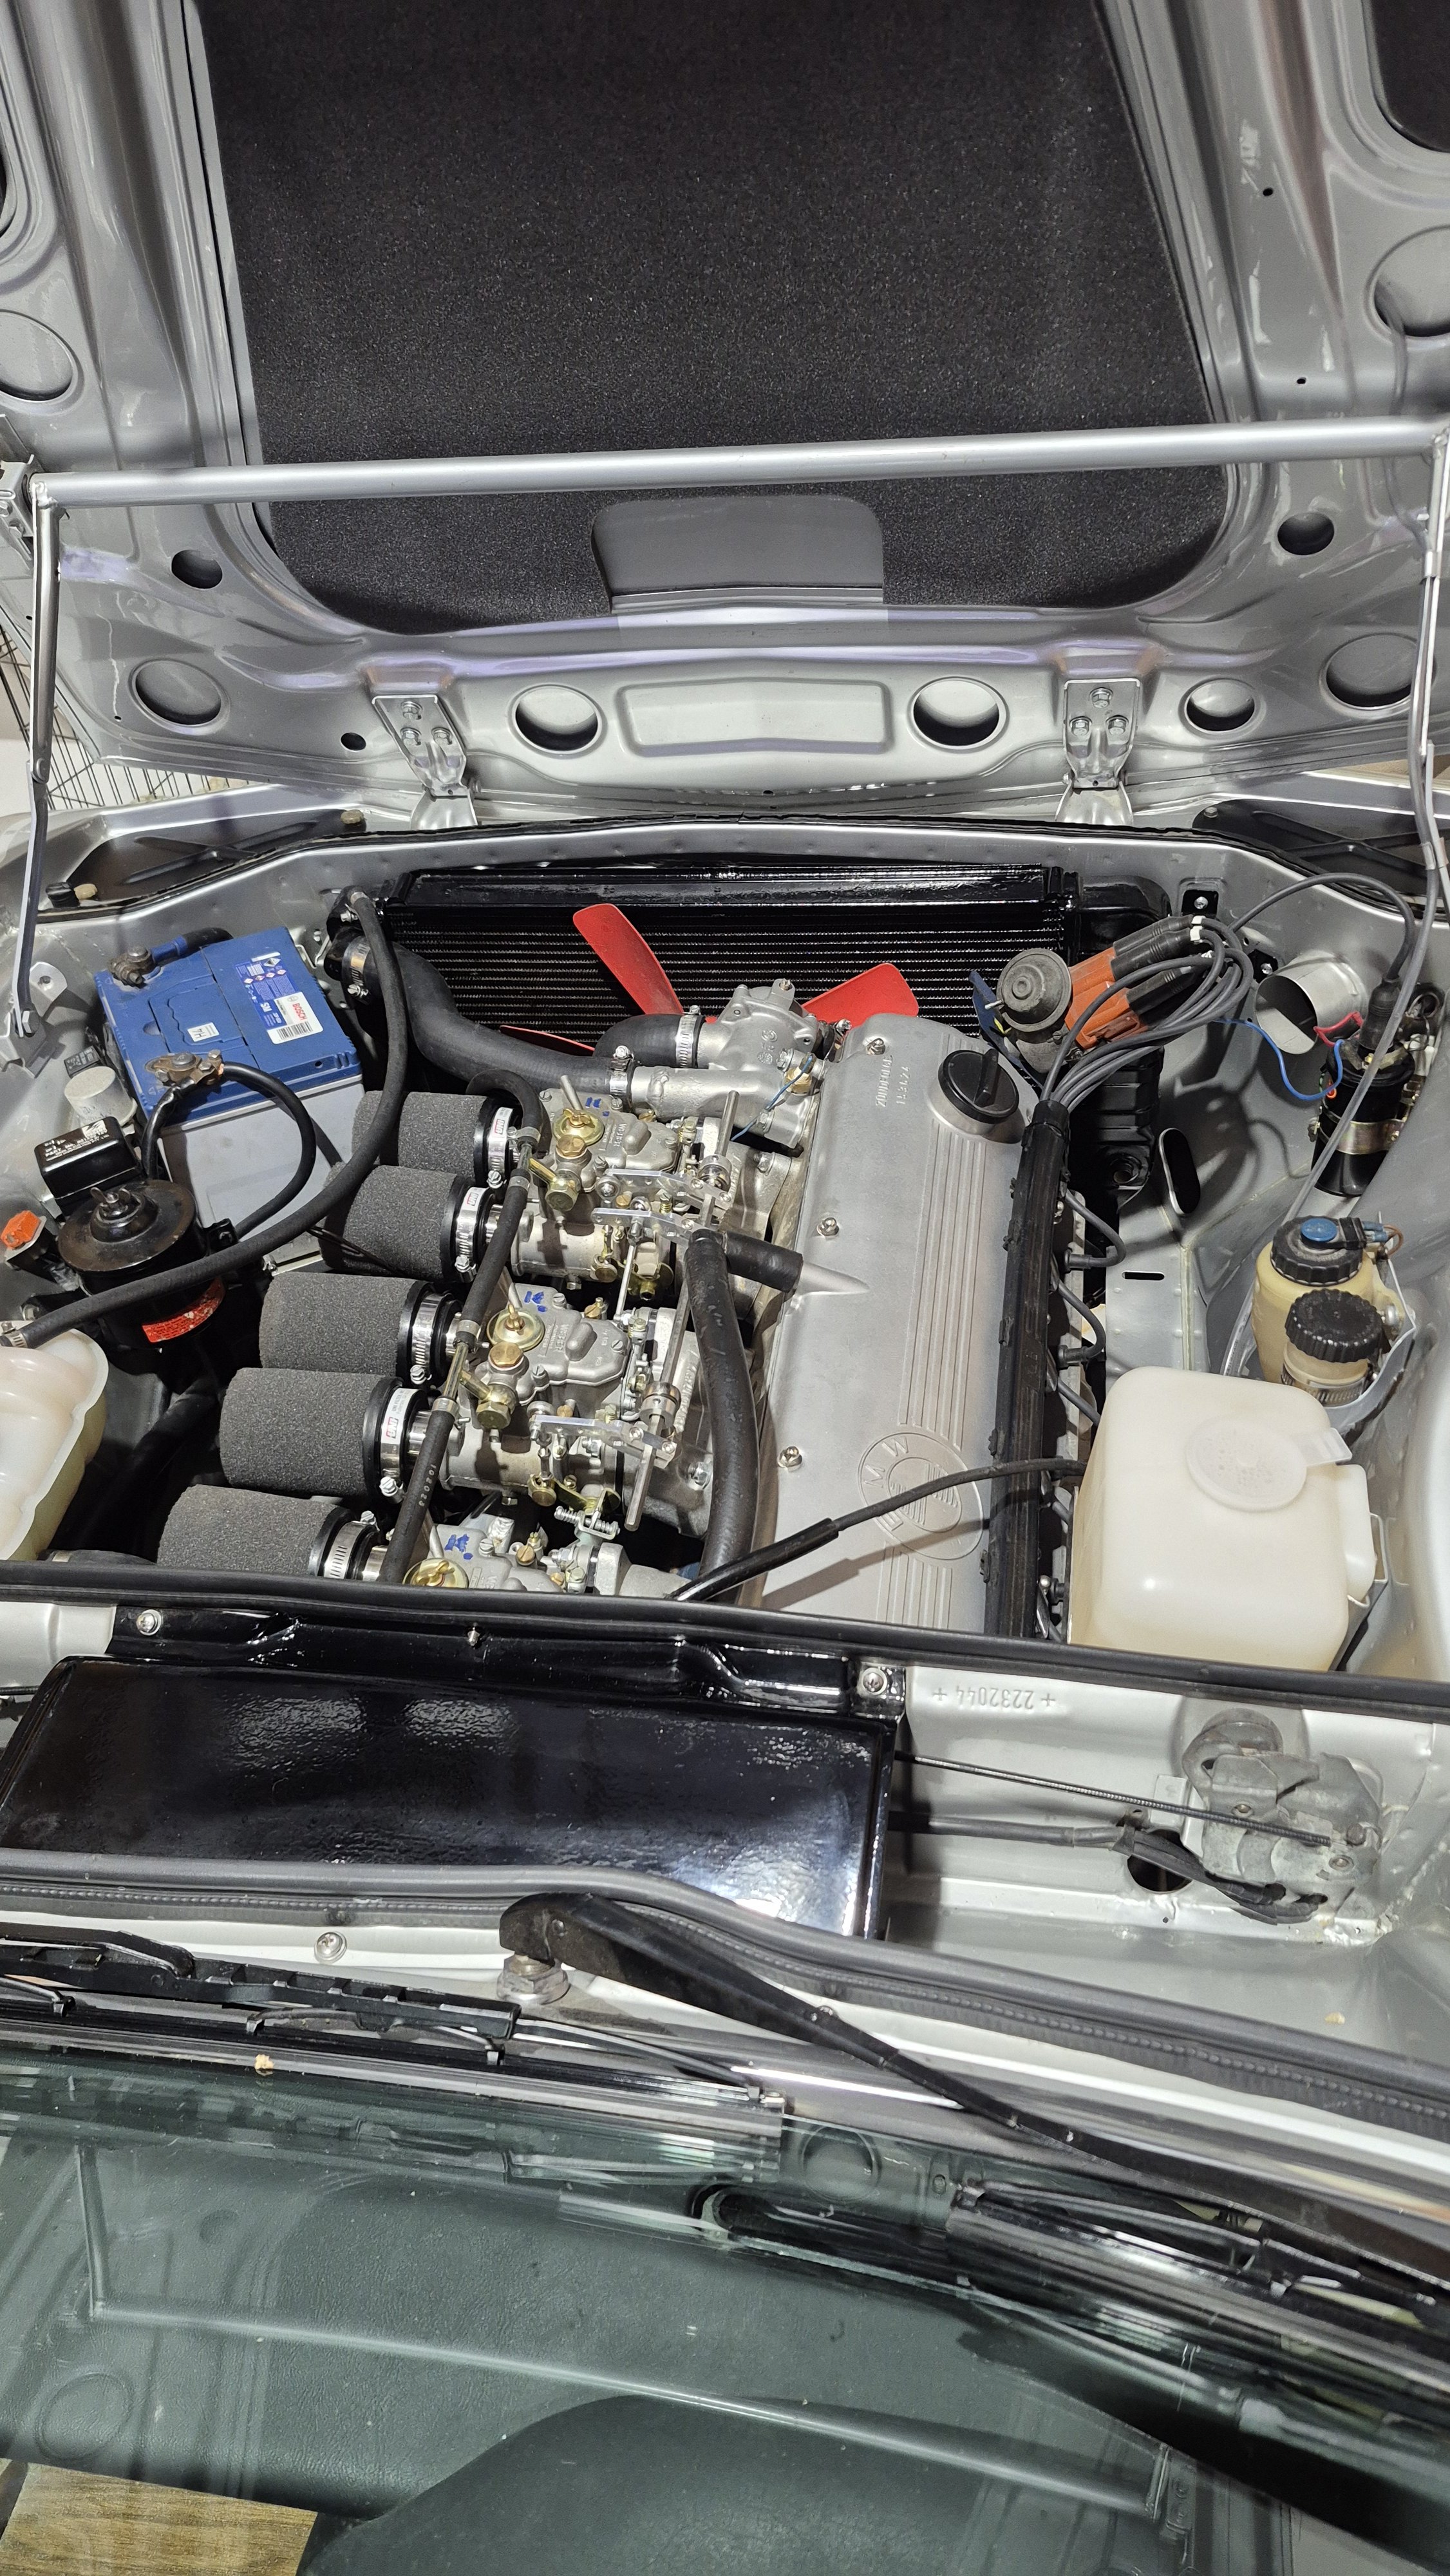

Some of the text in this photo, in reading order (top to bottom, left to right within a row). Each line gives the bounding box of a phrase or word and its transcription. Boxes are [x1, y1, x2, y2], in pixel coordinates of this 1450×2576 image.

[292, 1003, 308, 1021] BOSCH
[494, 1119, 505, 1134] UNI
[467, 1193, 478, 1206] UNI
[386, 1417, 399, 1439] UNI
[956, 1685, 1034, 1710] 2232044
